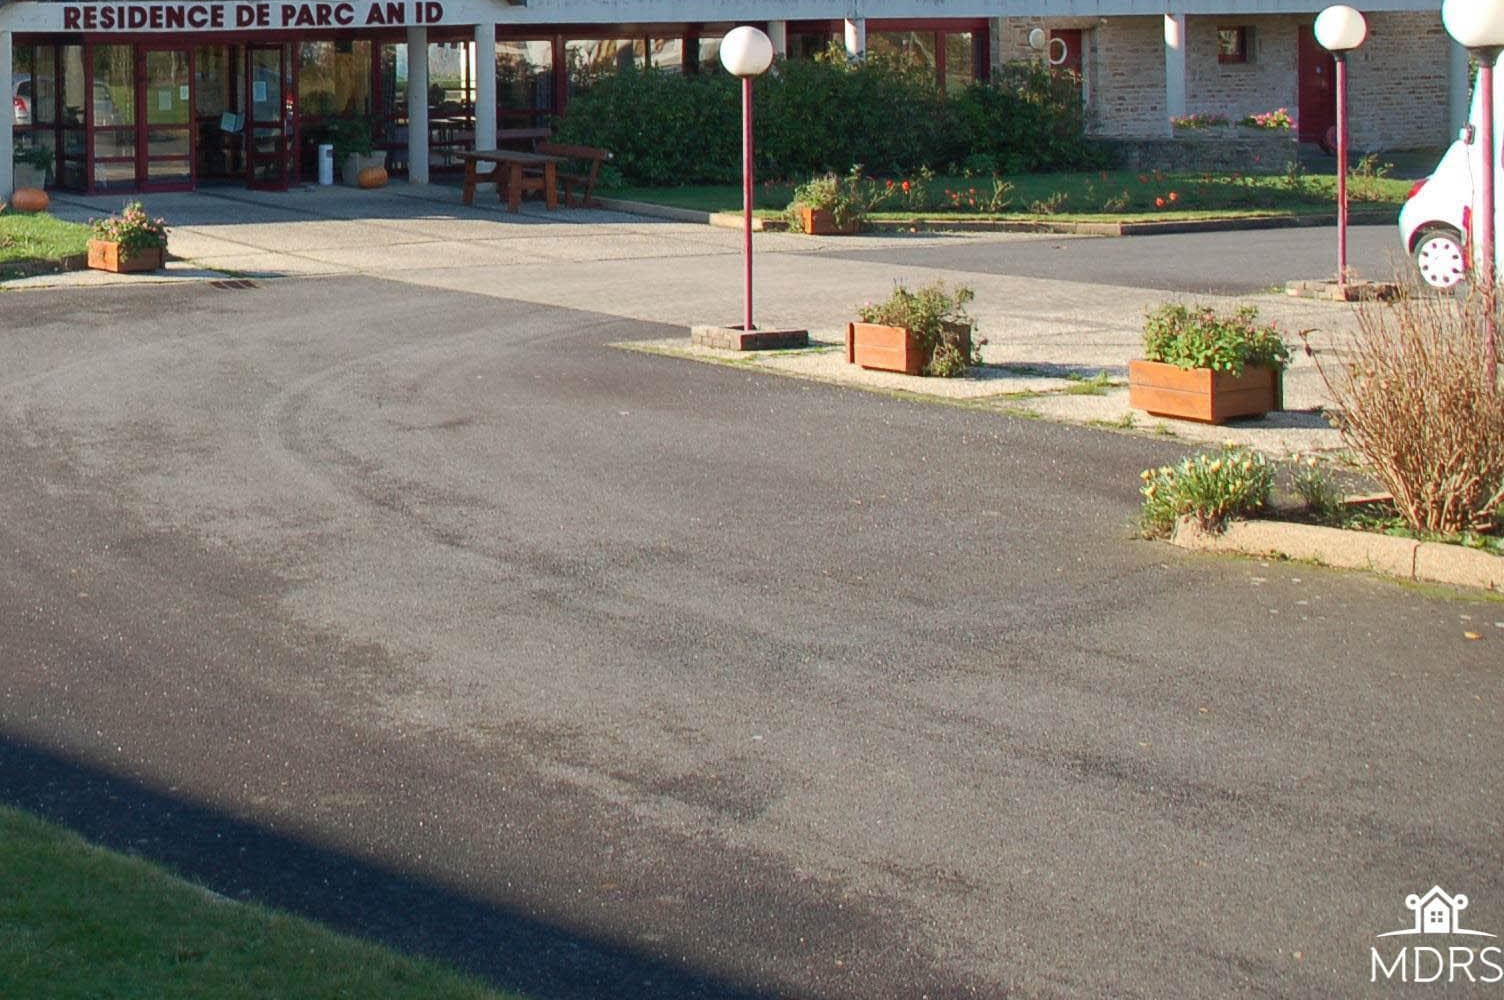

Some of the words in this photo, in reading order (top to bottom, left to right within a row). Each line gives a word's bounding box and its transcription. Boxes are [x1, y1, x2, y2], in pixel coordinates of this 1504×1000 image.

[63, 6, 224, 30] RESIDENCE
[235, 4, 270, 27] DE
[282, 2, 354, 26] PARC
[365, 1, 406, 25] AN
[415, 1, 444, 24] ID
